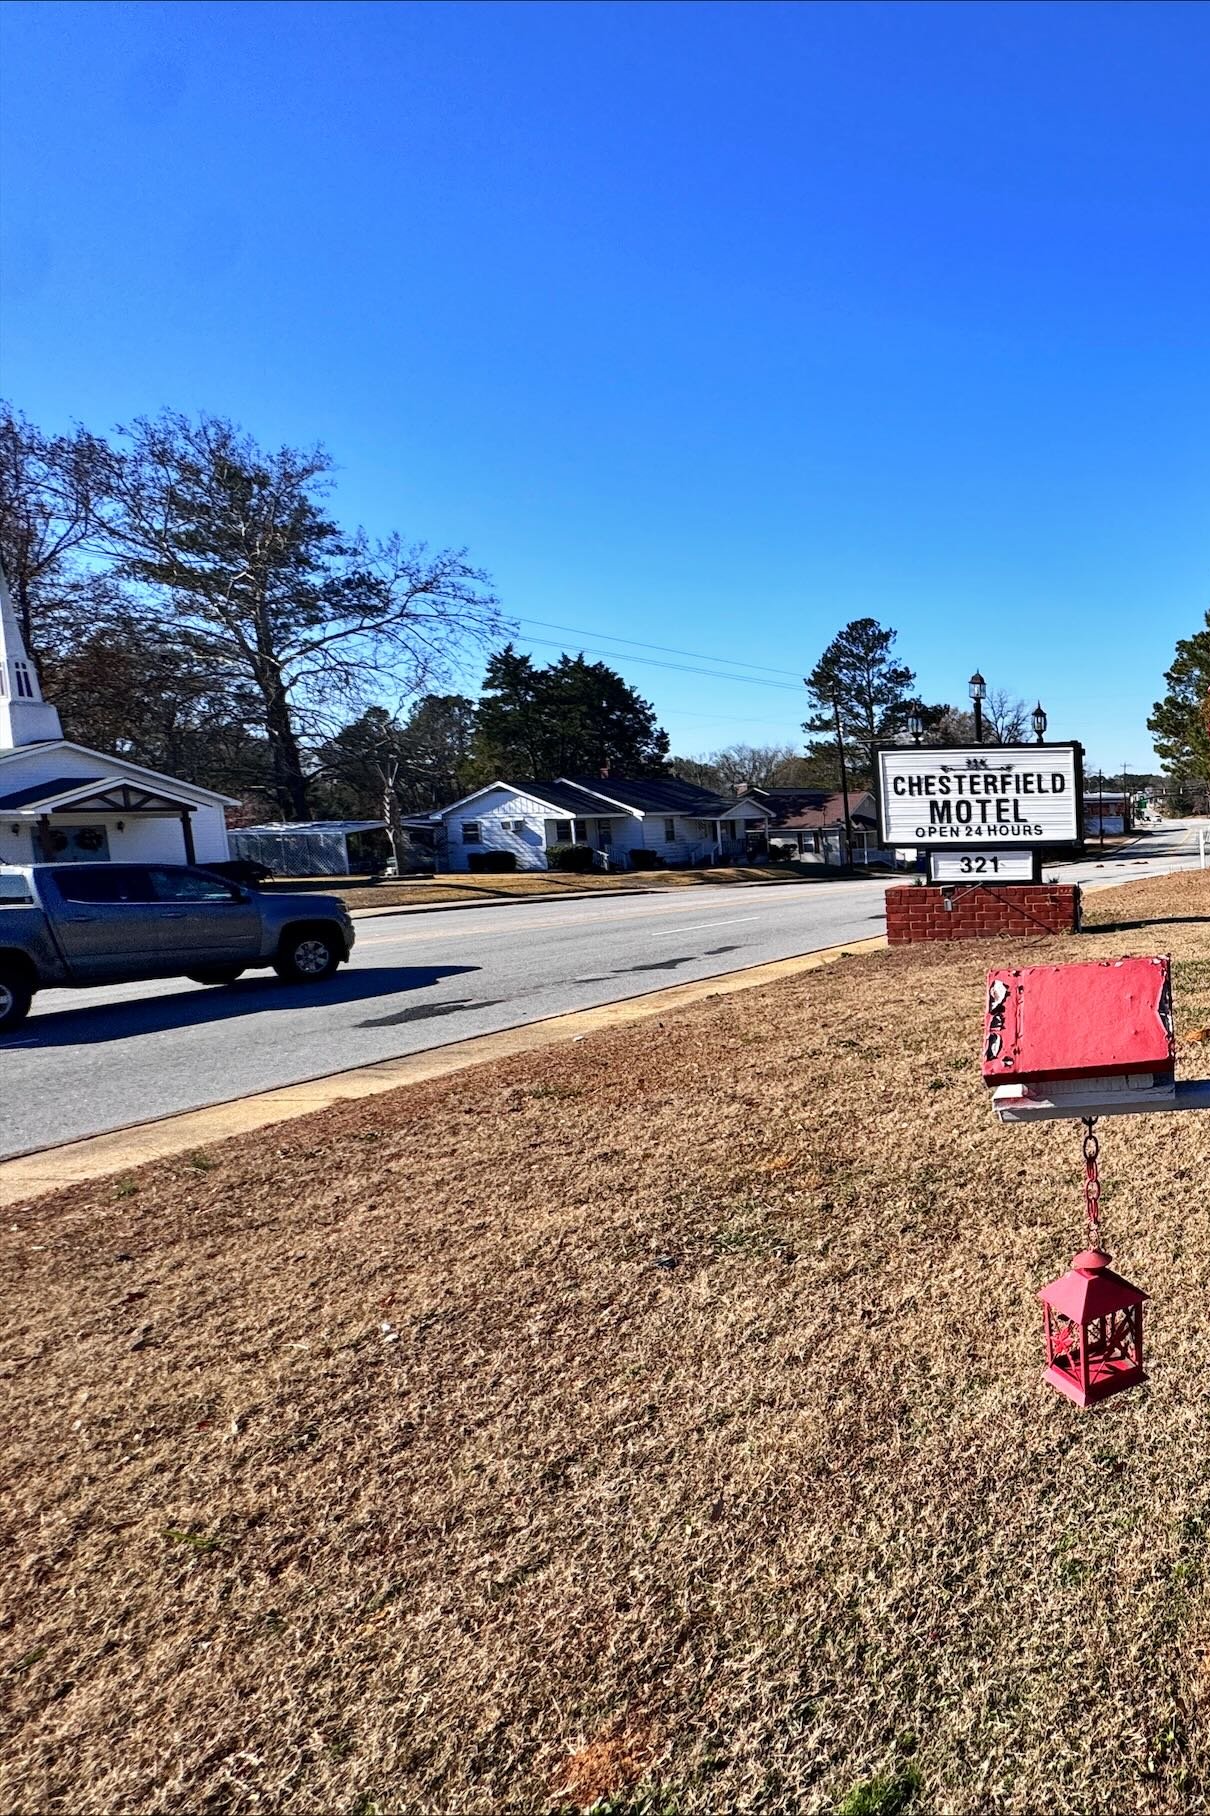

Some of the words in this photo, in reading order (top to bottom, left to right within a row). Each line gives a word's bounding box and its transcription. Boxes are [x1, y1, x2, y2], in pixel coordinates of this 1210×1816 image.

[893, 773, 1066, 797] CHESTERFIELD
[929, 798, 1029, 824] MOTEL
[915, 826, 960, 838] OPEN
[965, 826, 984, 837] 24
[988, 824, 1043, 837] HOURS
[960, 856, 999, 873] 321
